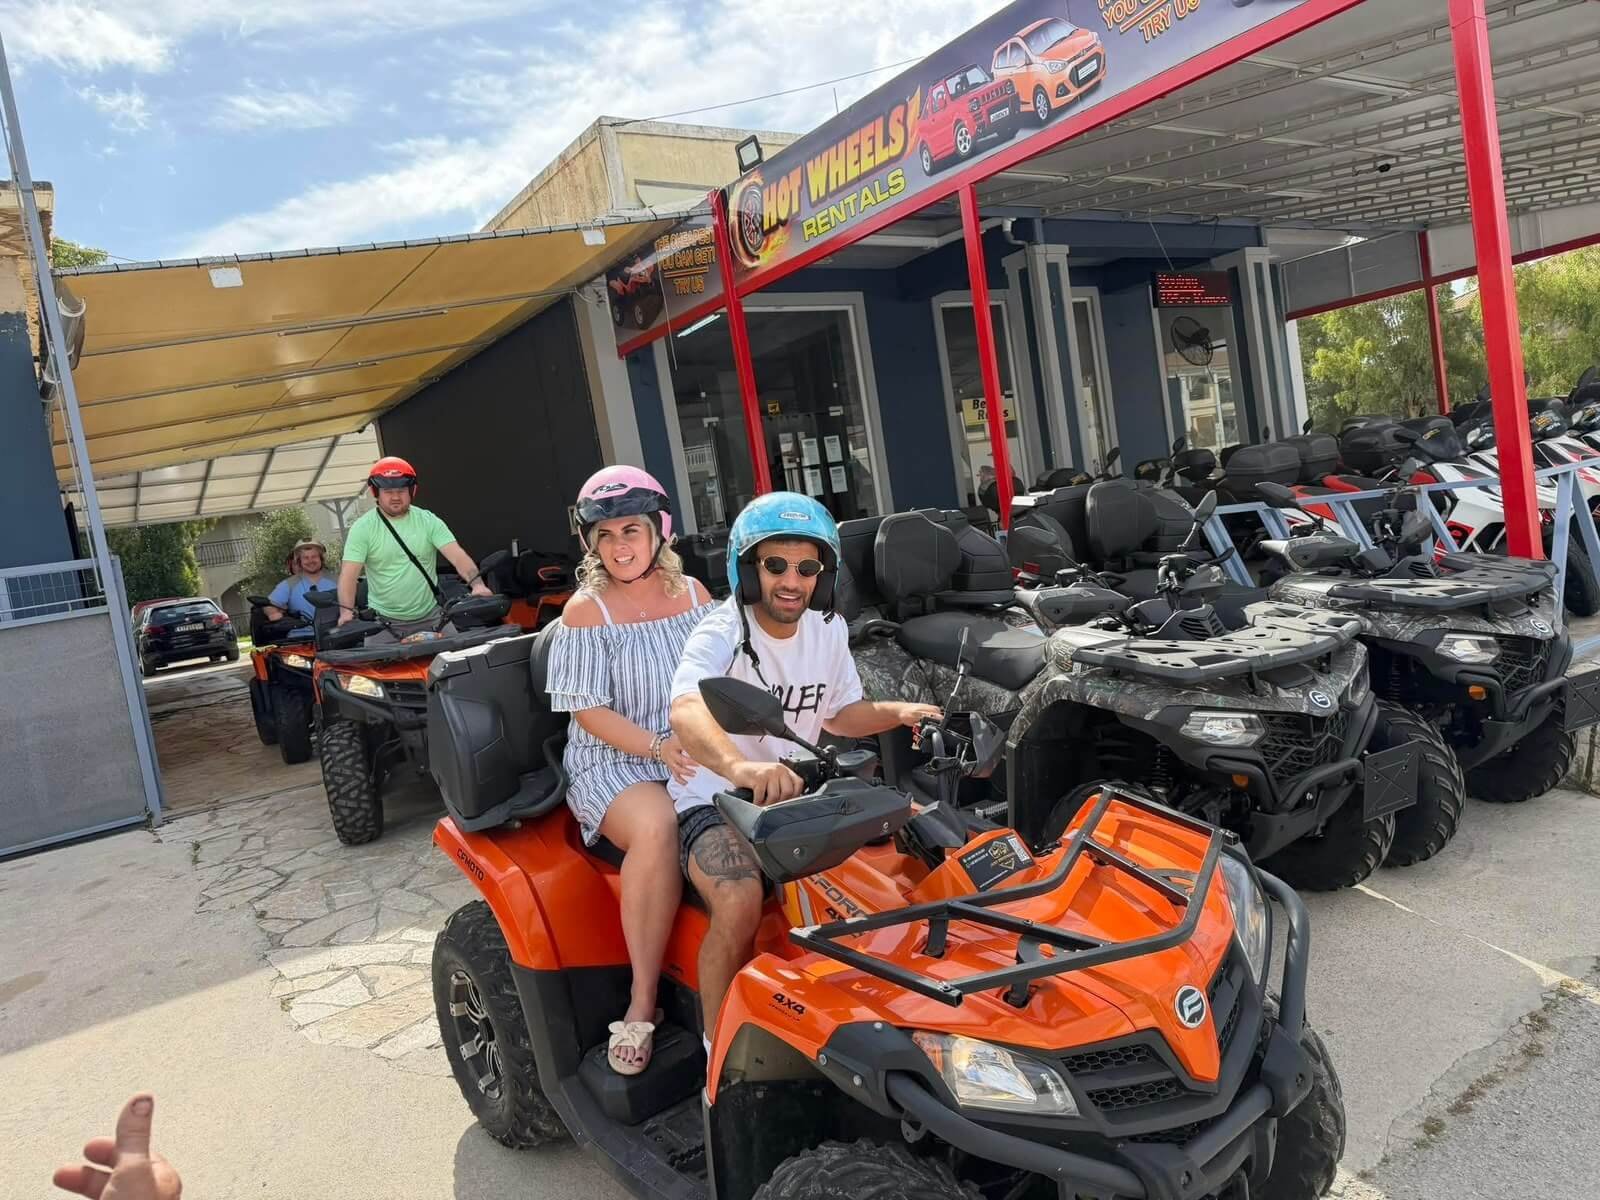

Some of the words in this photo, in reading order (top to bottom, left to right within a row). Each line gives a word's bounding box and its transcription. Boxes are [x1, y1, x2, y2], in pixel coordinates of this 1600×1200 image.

[1139, 3, 1172, 41] TRY
[763, 163, 802, 231] HOT
[806, 103, 907, 203] WHEELS
[802, 168, 907, 241] RENTALS
[456, 847, 485, 881] CFMOTO
